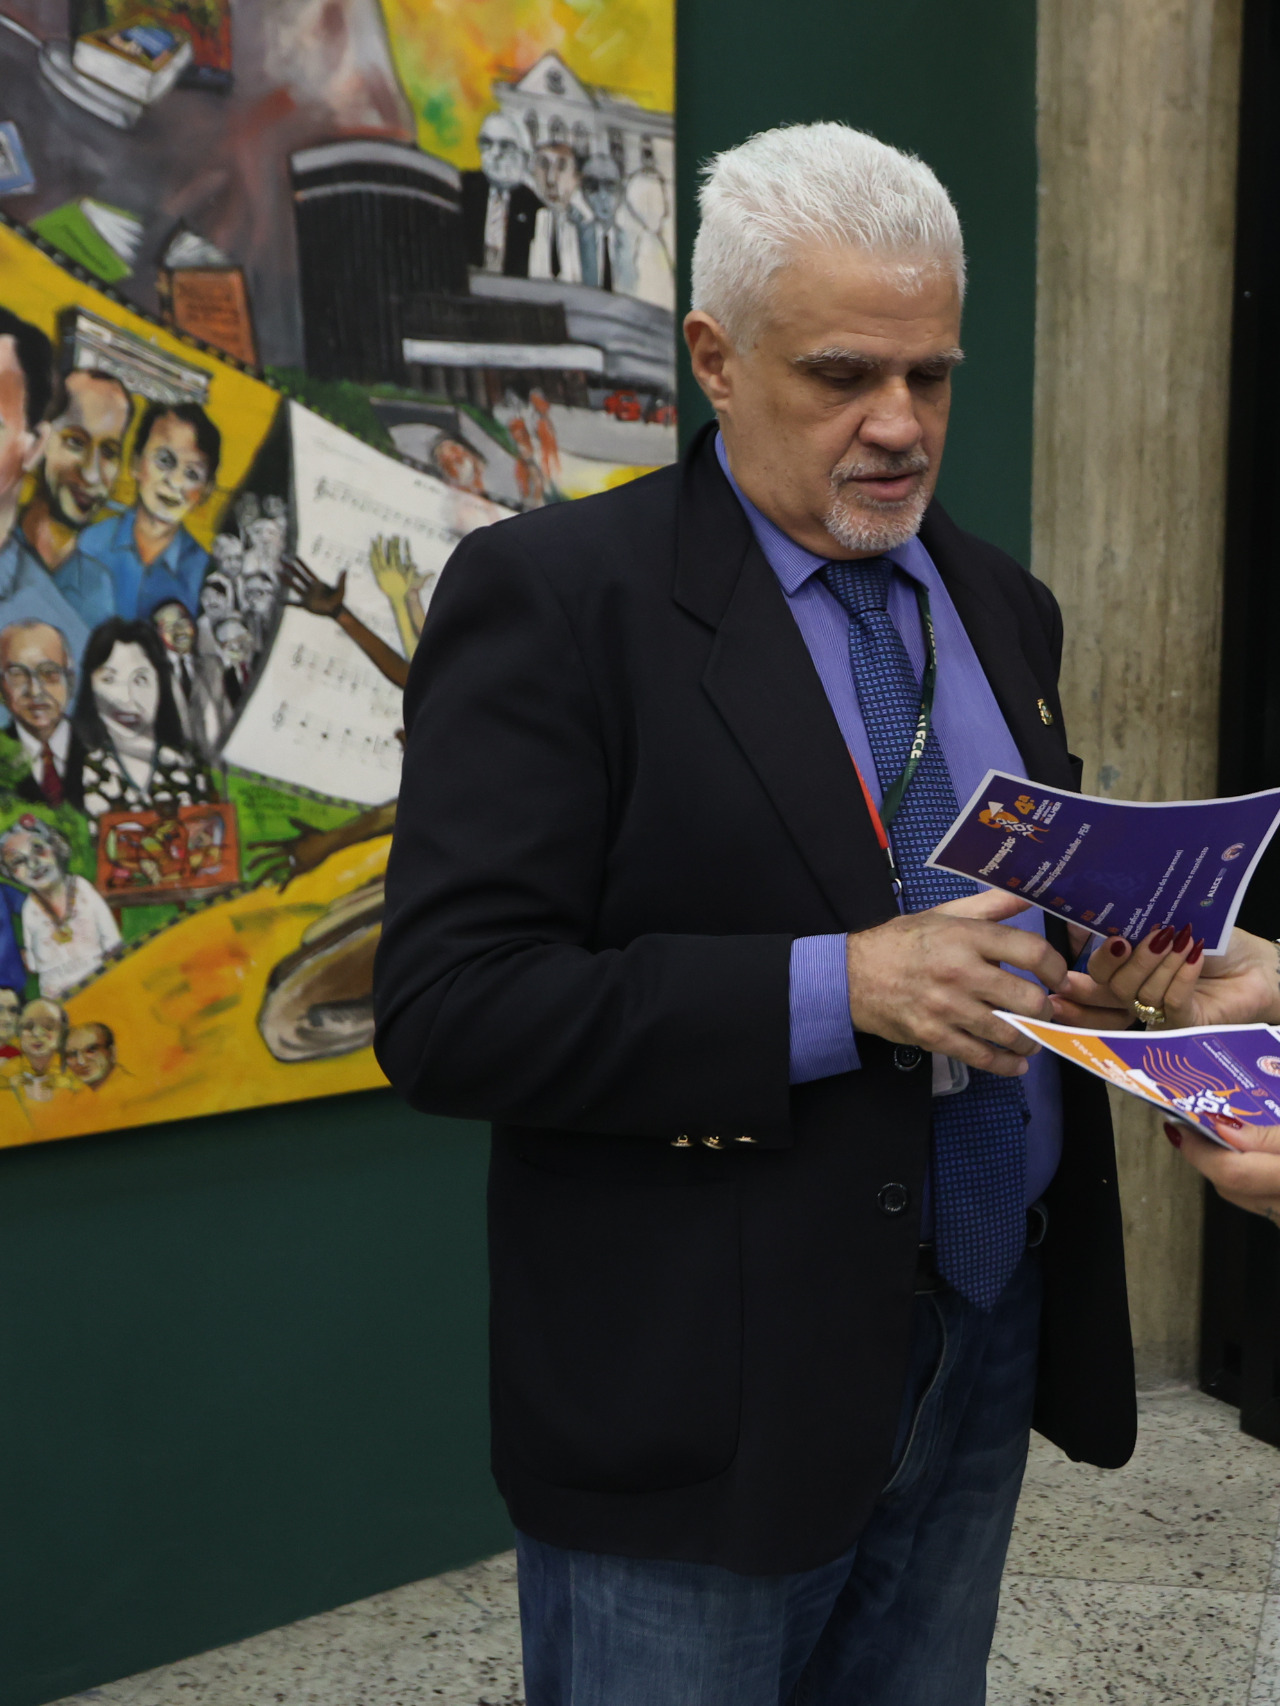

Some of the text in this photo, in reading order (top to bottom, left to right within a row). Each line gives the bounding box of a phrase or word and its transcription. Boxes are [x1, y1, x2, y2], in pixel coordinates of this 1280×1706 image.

[1032, 800, 1050, 820] MARCHA
[1044, 802, 1062, 824] MULHER
[1065, 838, 1082, 856] Mulher
[1078, 823, 1091, 836] PEM
[978, 836, 1016, 876] Programação:
[1150, 886, 1163, 902] Praça
[1162, 912, 1174, 924] final
[1177, 879, 1191, 898] música
[1190, 846, 1209, 875] manifesto
[1207, 876, 1223, 897] ALECE
[1120, 908, 1142, 938] aída oficial
